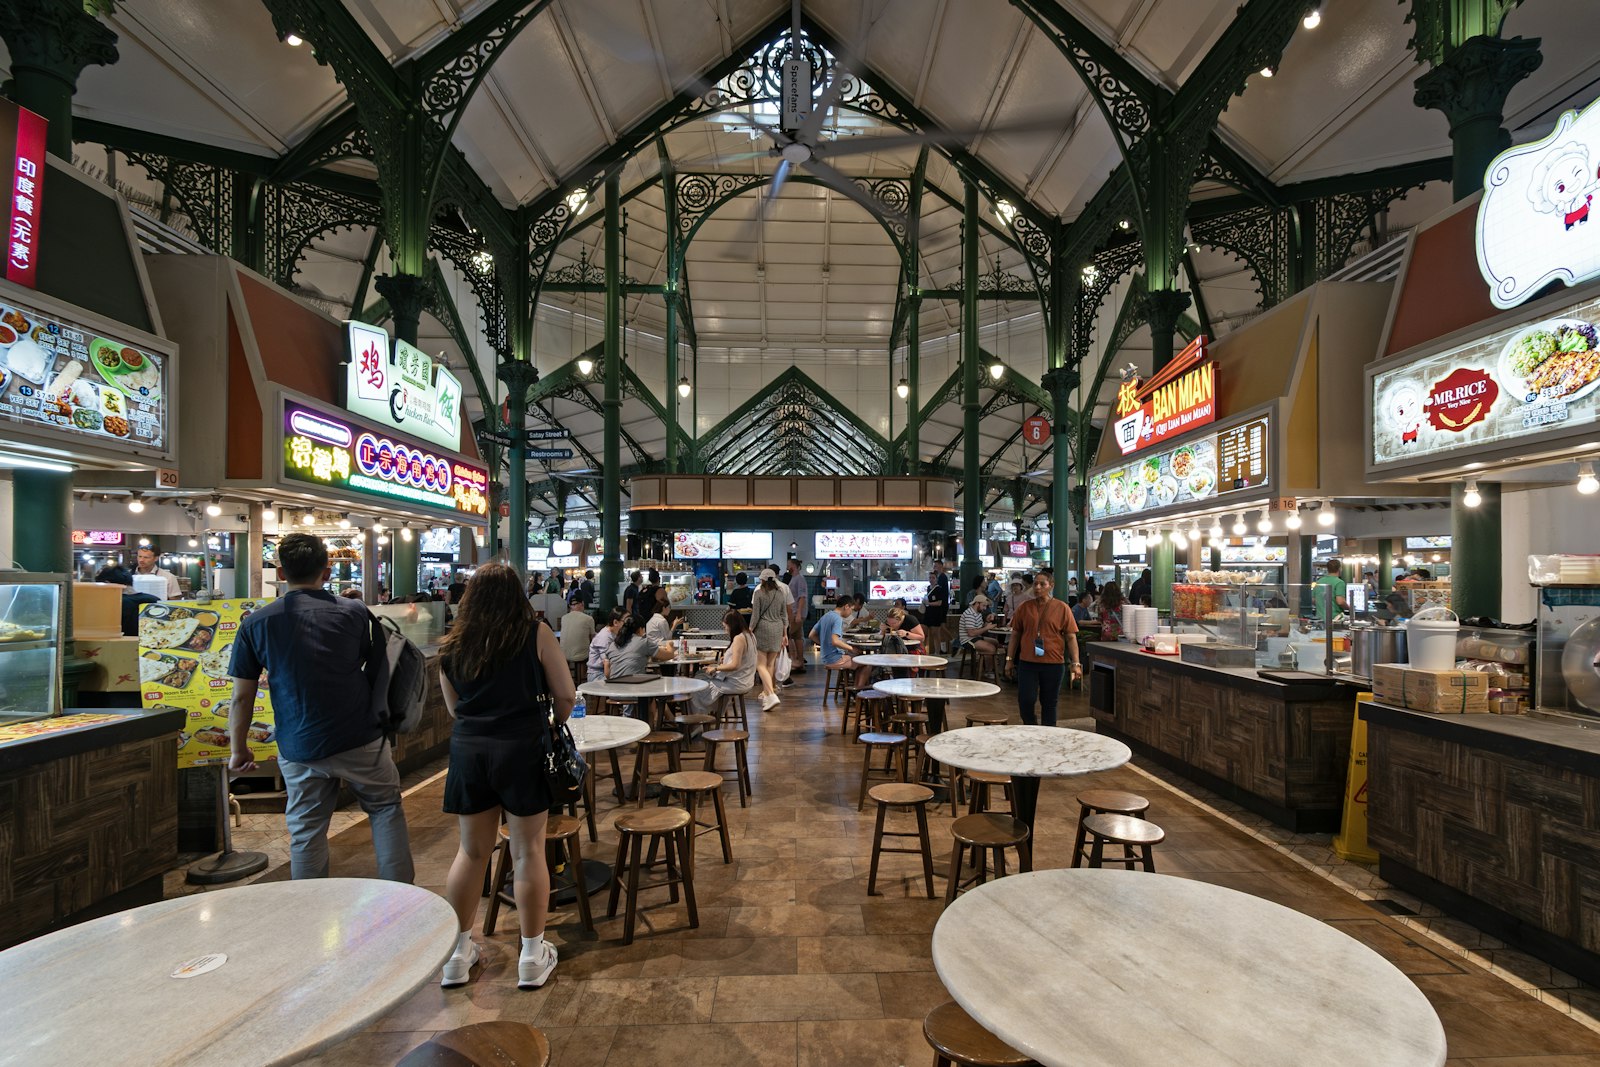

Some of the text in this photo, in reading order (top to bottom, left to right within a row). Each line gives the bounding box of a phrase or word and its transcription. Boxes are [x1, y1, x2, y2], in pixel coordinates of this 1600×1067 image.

[791, 65, 799, 113] Spacefans
[49, 324, 59, 333] 12
[360, 340, 384, 389] 鸡
[21, 386, 32, 396] 13
[1152, 363, 1212, 422] BAN MIAN
[1526, 393, 1537, 402] 06
[1117, 378, 1141, 418] 板
[1167, 418, 1181, 431] LIAN
[1180, 413, 1193, 425] BAN
[1192, 404, 1212, 418] MIAN)
[529, 432, 545, 440] Satay
[1033, 427, 1040, 440] 6
[1121, 419, 1137, 443] 面
[530, 450, 563, 458] Restrooms
[361, 442, 448, 487] 正宗海南鸡饭
[162, 472, 177, 484] 20
[1283, 500, 1294, 508] 16
